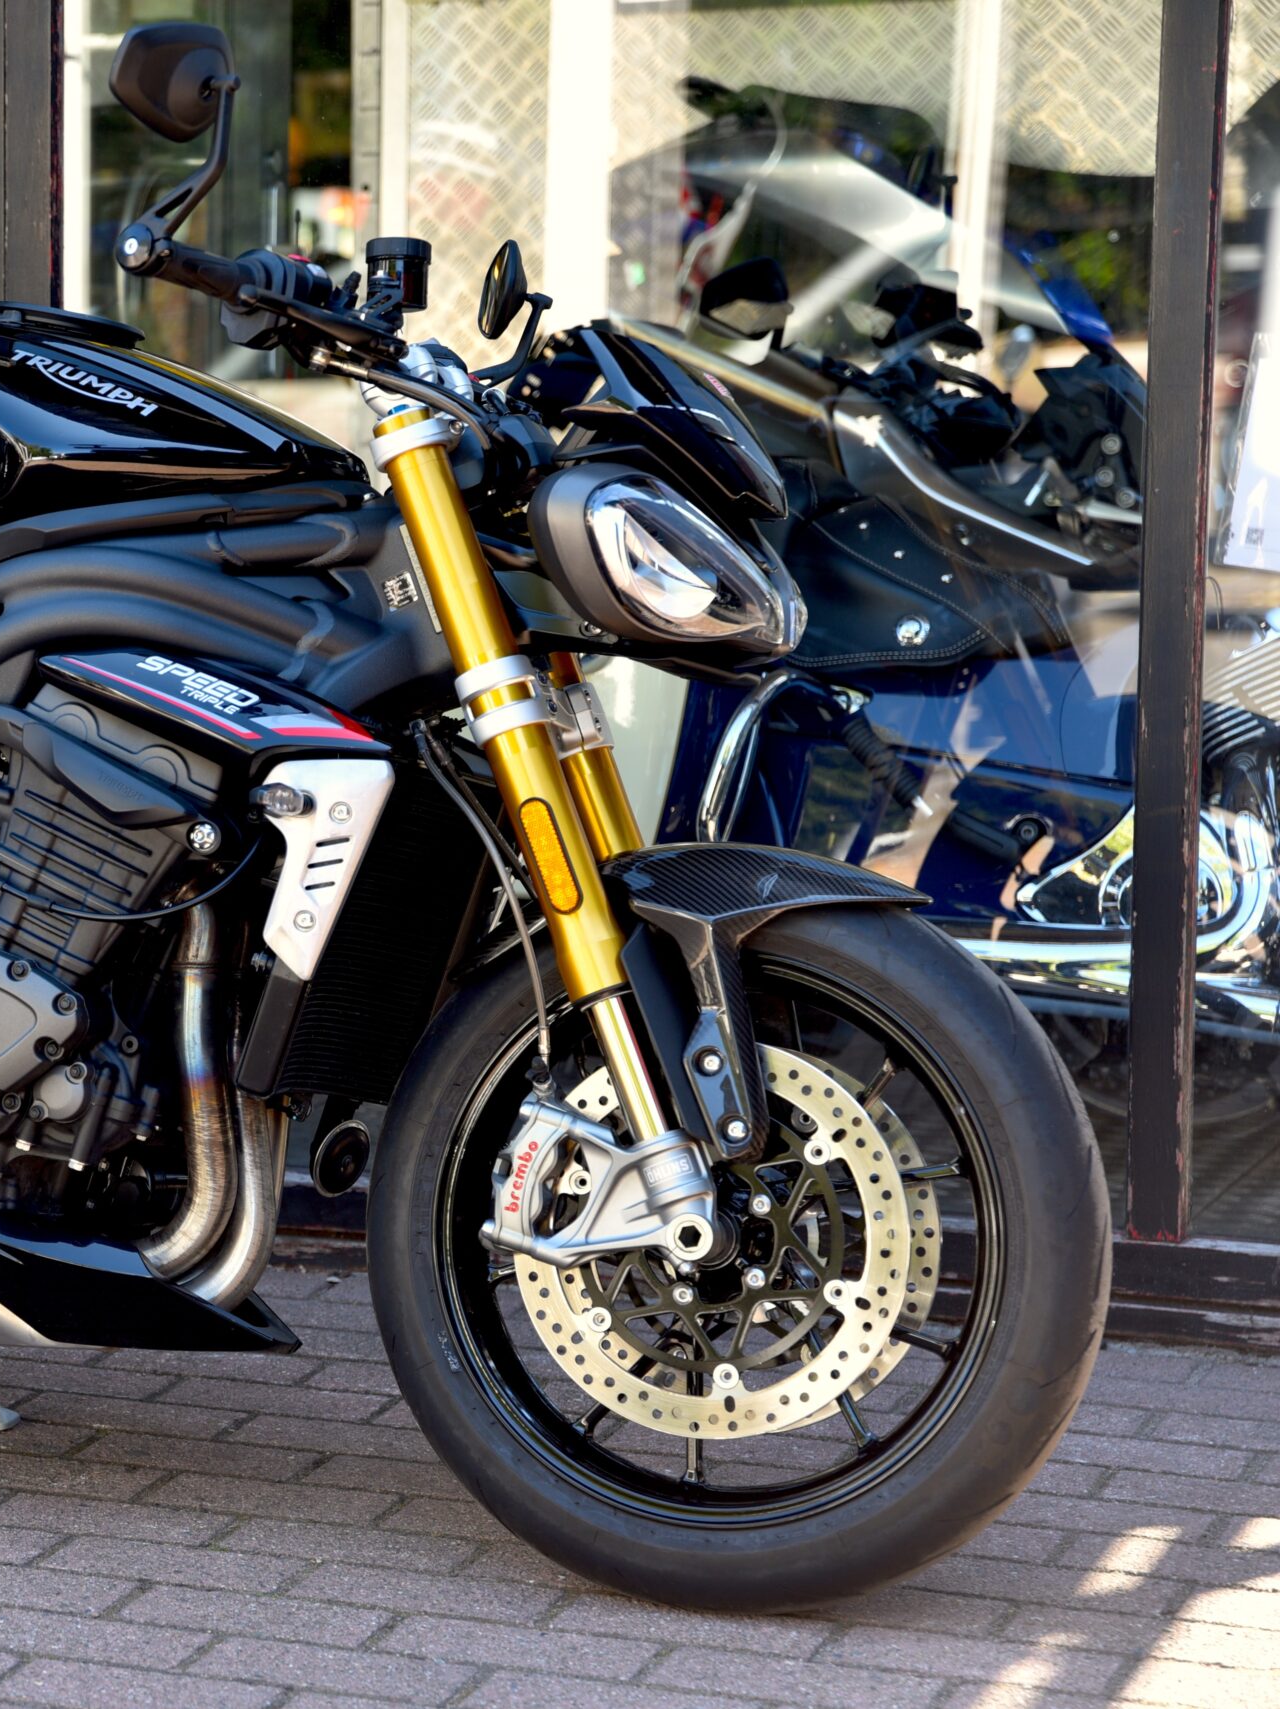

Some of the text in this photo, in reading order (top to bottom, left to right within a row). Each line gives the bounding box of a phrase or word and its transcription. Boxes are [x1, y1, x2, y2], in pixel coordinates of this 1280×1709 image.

[11, 350, 159, 417] TRIUMPH
[136, 655, 260, 708] SPEED
[180, 685, 241, 715] TRIPLE
[504, 1141, 539, 1213] brembo
